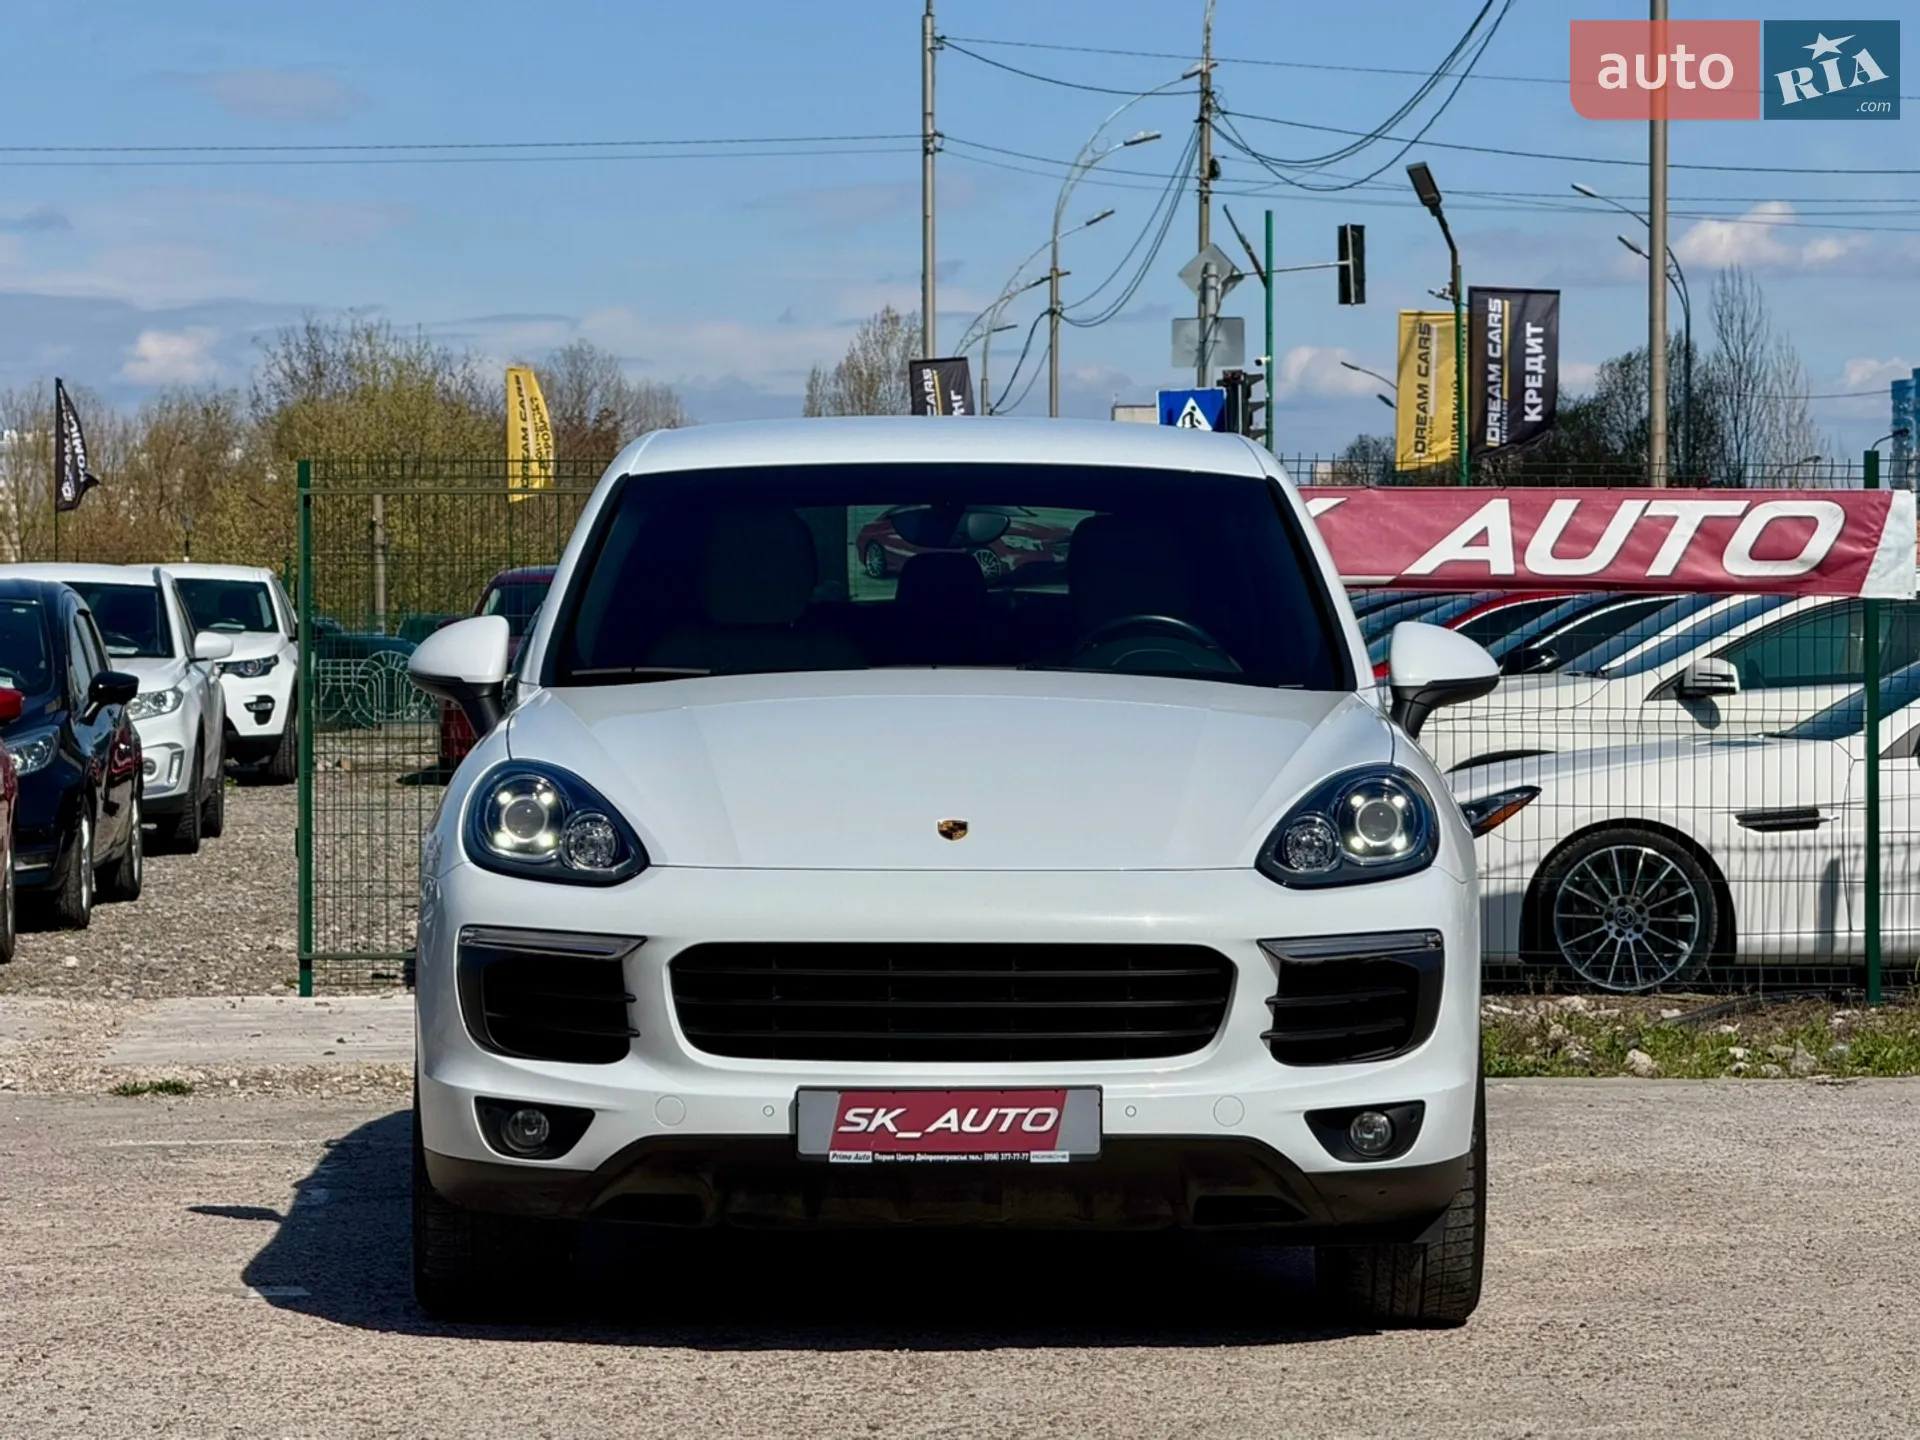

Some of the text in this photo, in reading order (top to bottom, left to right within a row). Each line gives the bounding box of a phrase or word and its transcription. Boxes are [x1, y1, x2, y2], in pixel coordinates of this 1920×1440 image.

[1414, 323, 1431, 453] DREAM CARS
[1487, 298, 1503, 442] DREAM CARS
[1524, 322, 1546, 422] КРЕДИТ
[837, 1108, 1059, 1138] SK_AUTO
[853, 1152, 871, 1161] Auto
